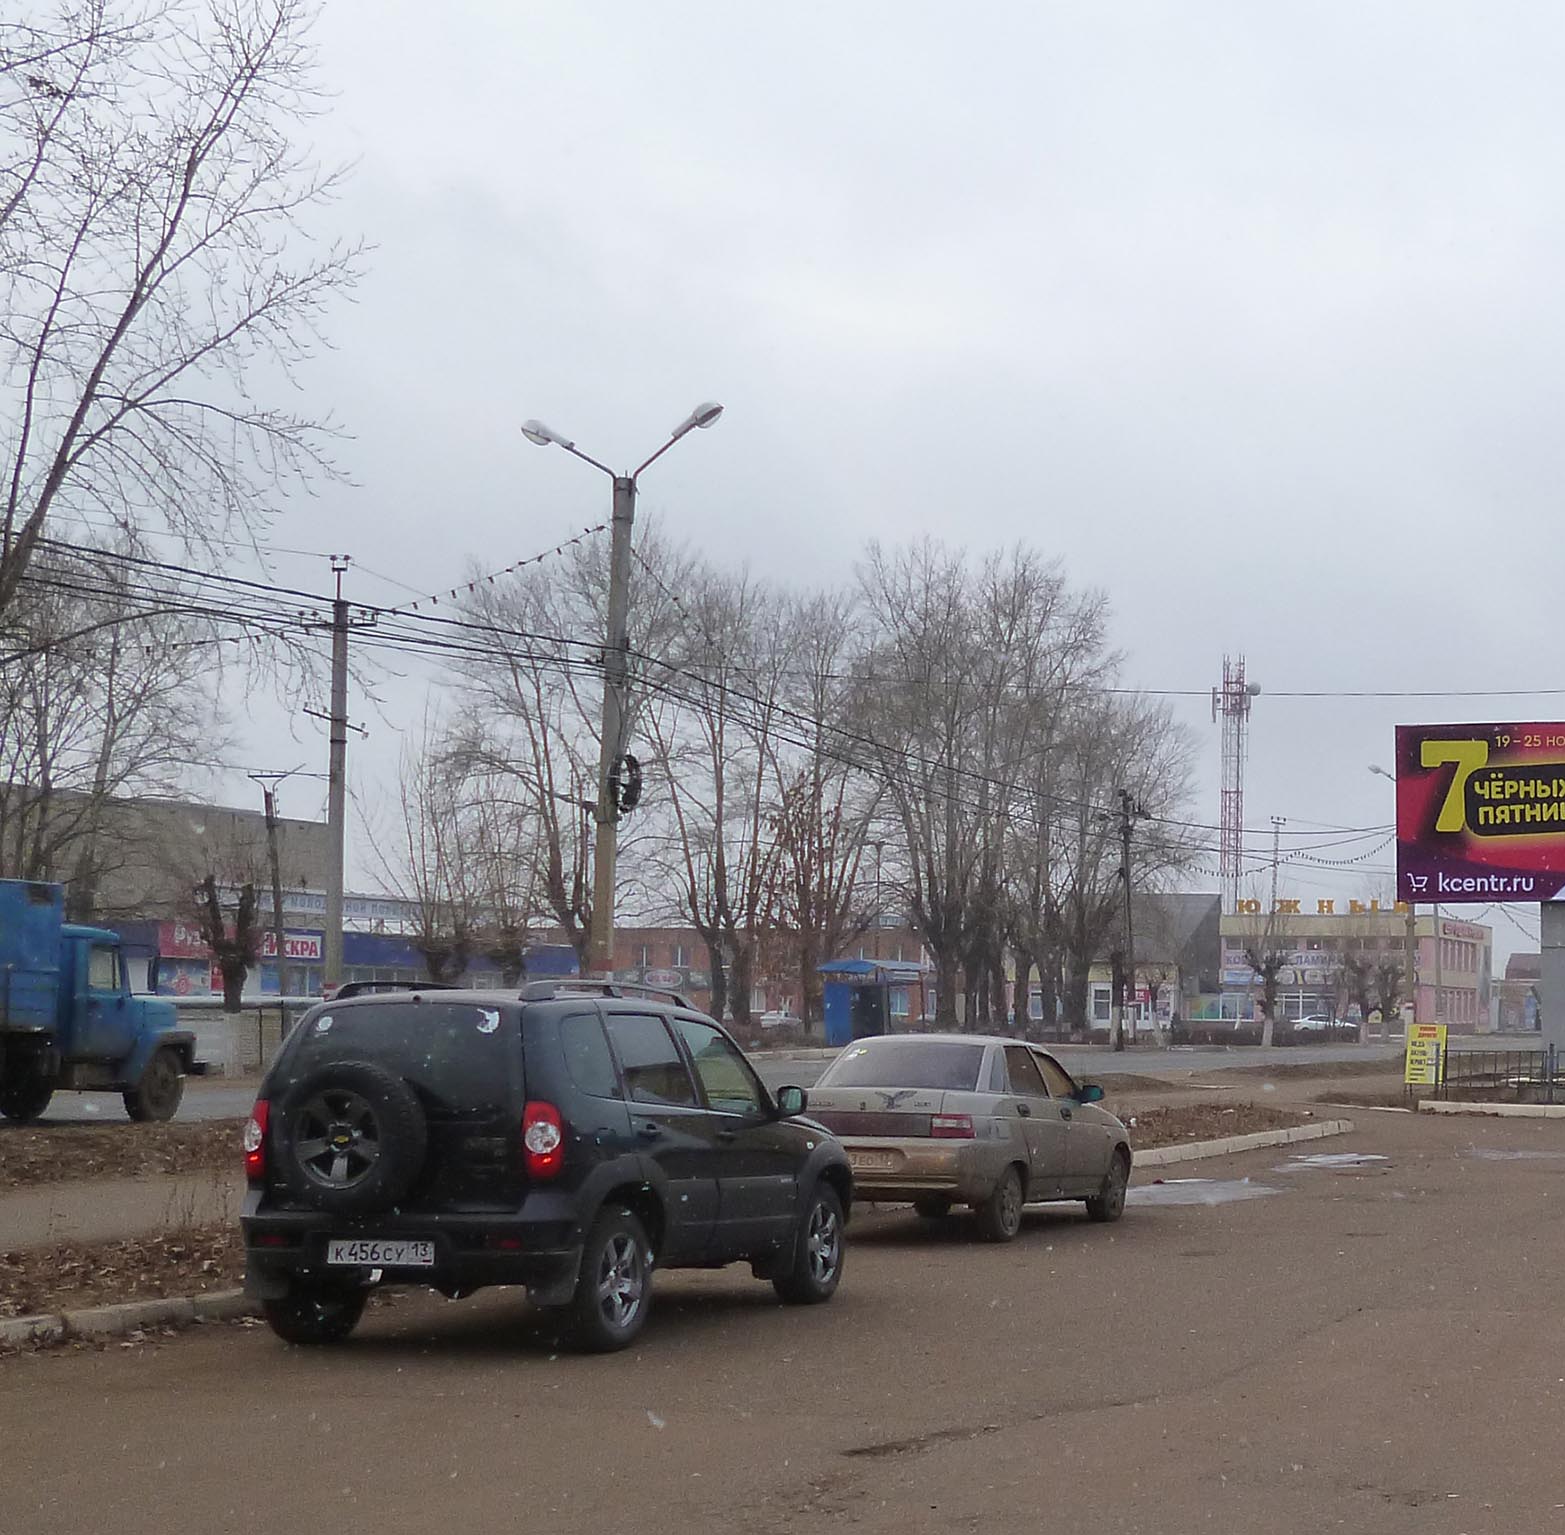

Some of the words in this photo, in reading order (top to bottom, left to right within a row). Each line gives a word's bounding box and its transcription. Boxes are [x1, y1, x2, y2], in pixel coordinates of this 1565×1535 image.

[1495, 735, 1510, 748] 19
[1524, 735, 1541, 747] 25
[1420, 740, 1489, 832] 7
[1438, 872, 1534, 892] kcentr.ru
[412, 1243, 428, 1256] 13
